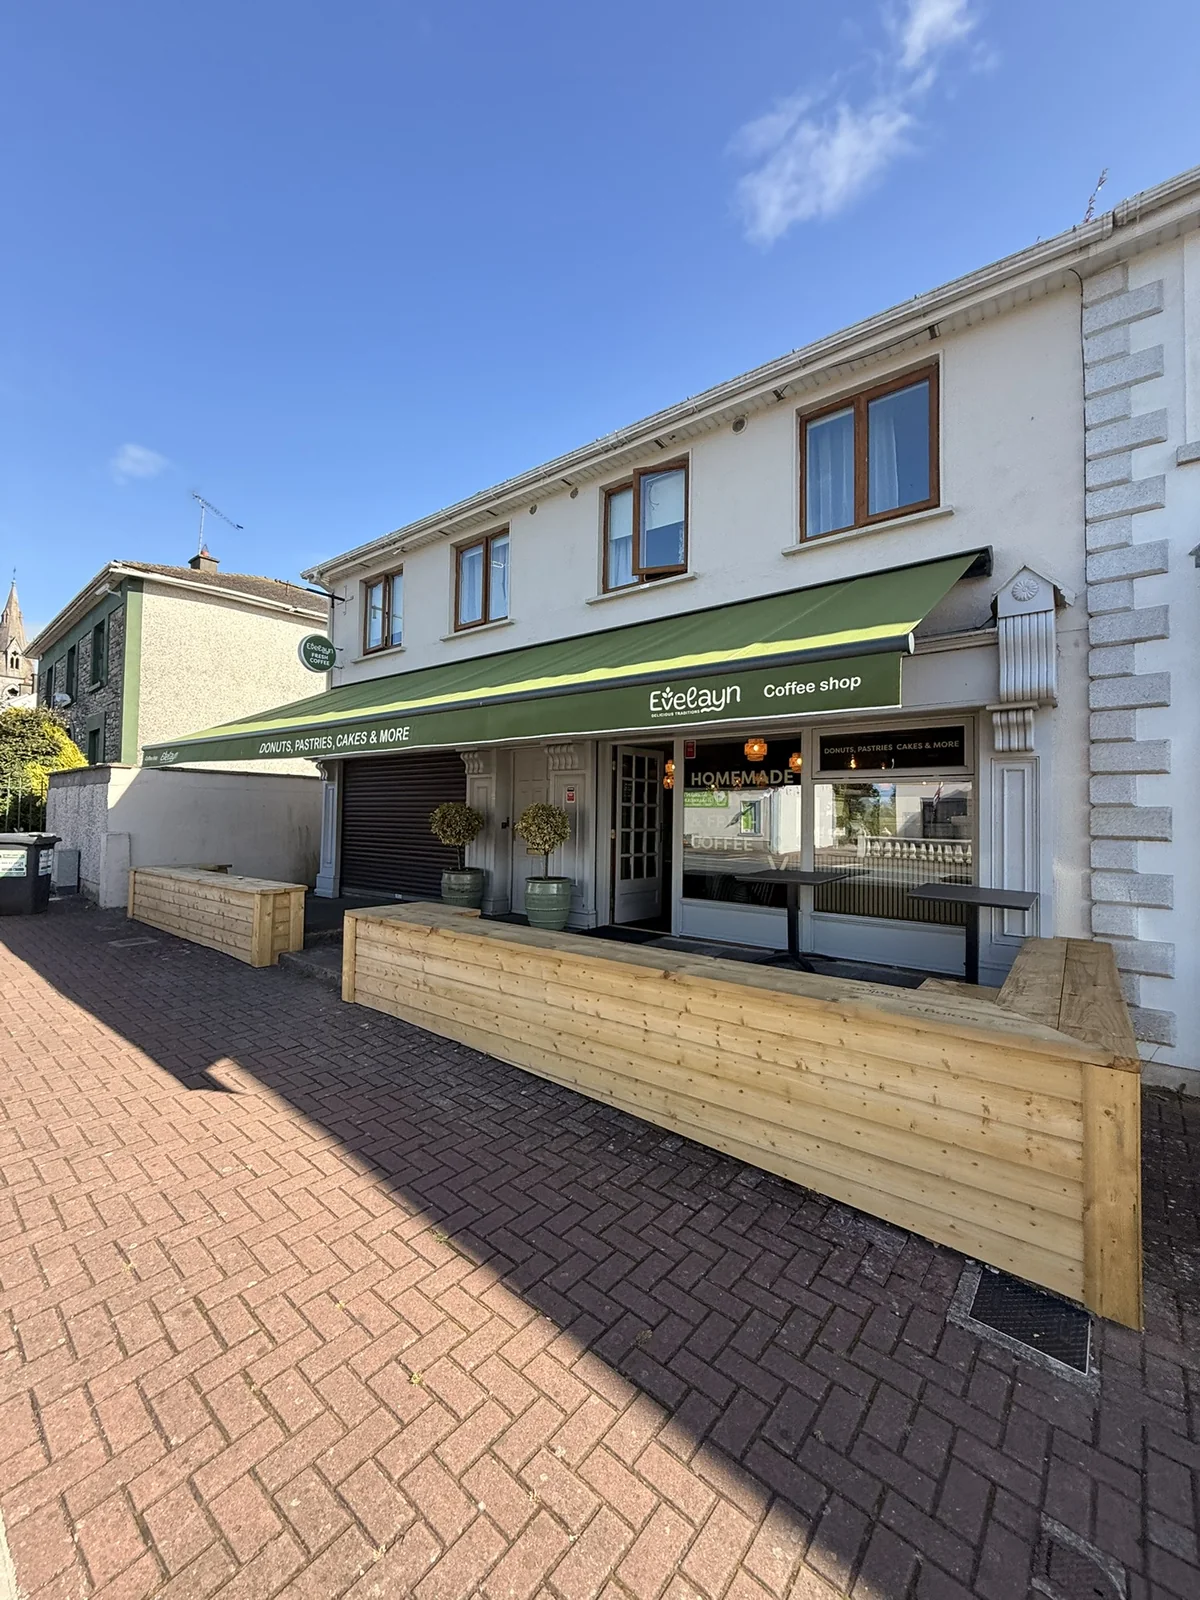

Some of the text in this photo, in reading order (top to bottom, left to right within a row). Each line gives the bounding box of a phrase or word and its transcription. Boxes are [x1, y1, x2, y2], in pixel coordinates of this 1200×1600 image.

[310, 657, 330, 666] COFFEE
[763, 676, 862, 698] Coffee shop
[649, 685, 741, 713] Evelayn
[259, 726, 410, 754] DONUTS, PASTRIES, CAKES & MORE
[824, 740, 960, 755] DONUTS, PASTRIES CAKES & MORE
[691, 769, 794, 787] HOMEMADE
[691, 834, 753, 851] COFFEE
